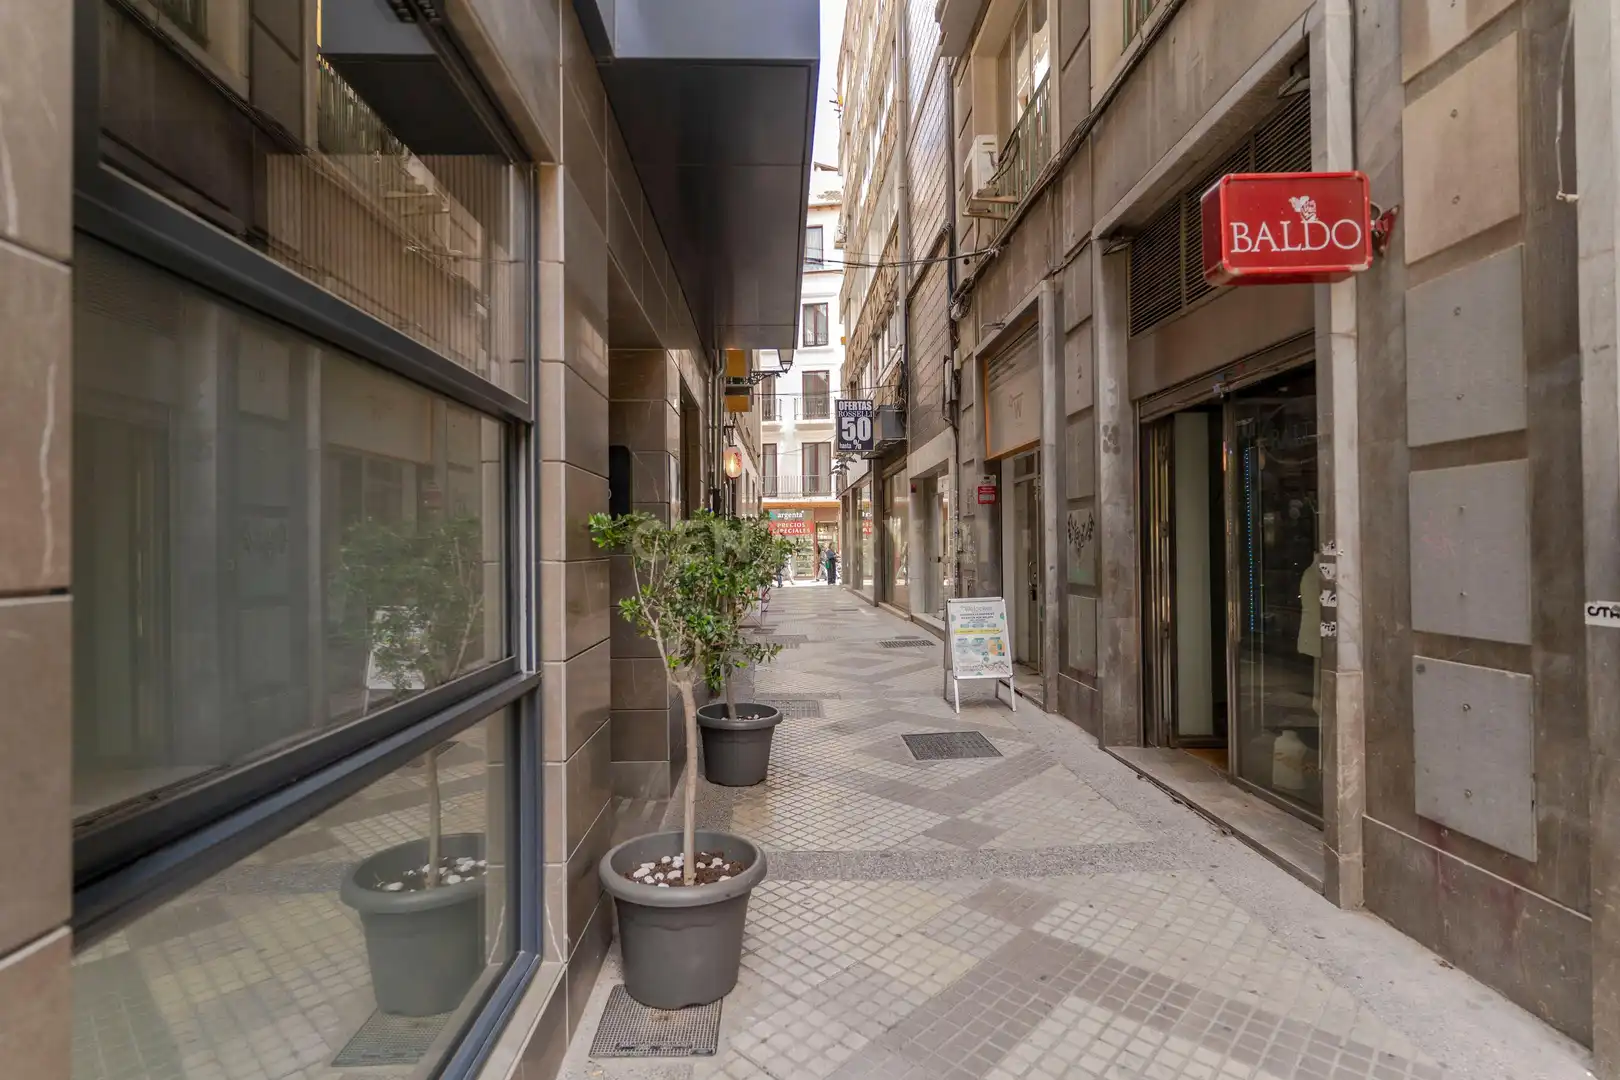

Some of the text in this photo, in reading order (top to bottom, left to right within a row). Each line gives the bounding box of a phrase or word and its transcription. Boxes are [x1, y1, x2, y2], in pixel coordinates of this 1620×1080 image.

[1230, 218, 1362, 253] BALDO
[838, 401, 872, 411] OFERTAS
[841, 417, 871, 441] 50
[852, 439, 862, 450] %
[777, 511, 803, 520] argenta
